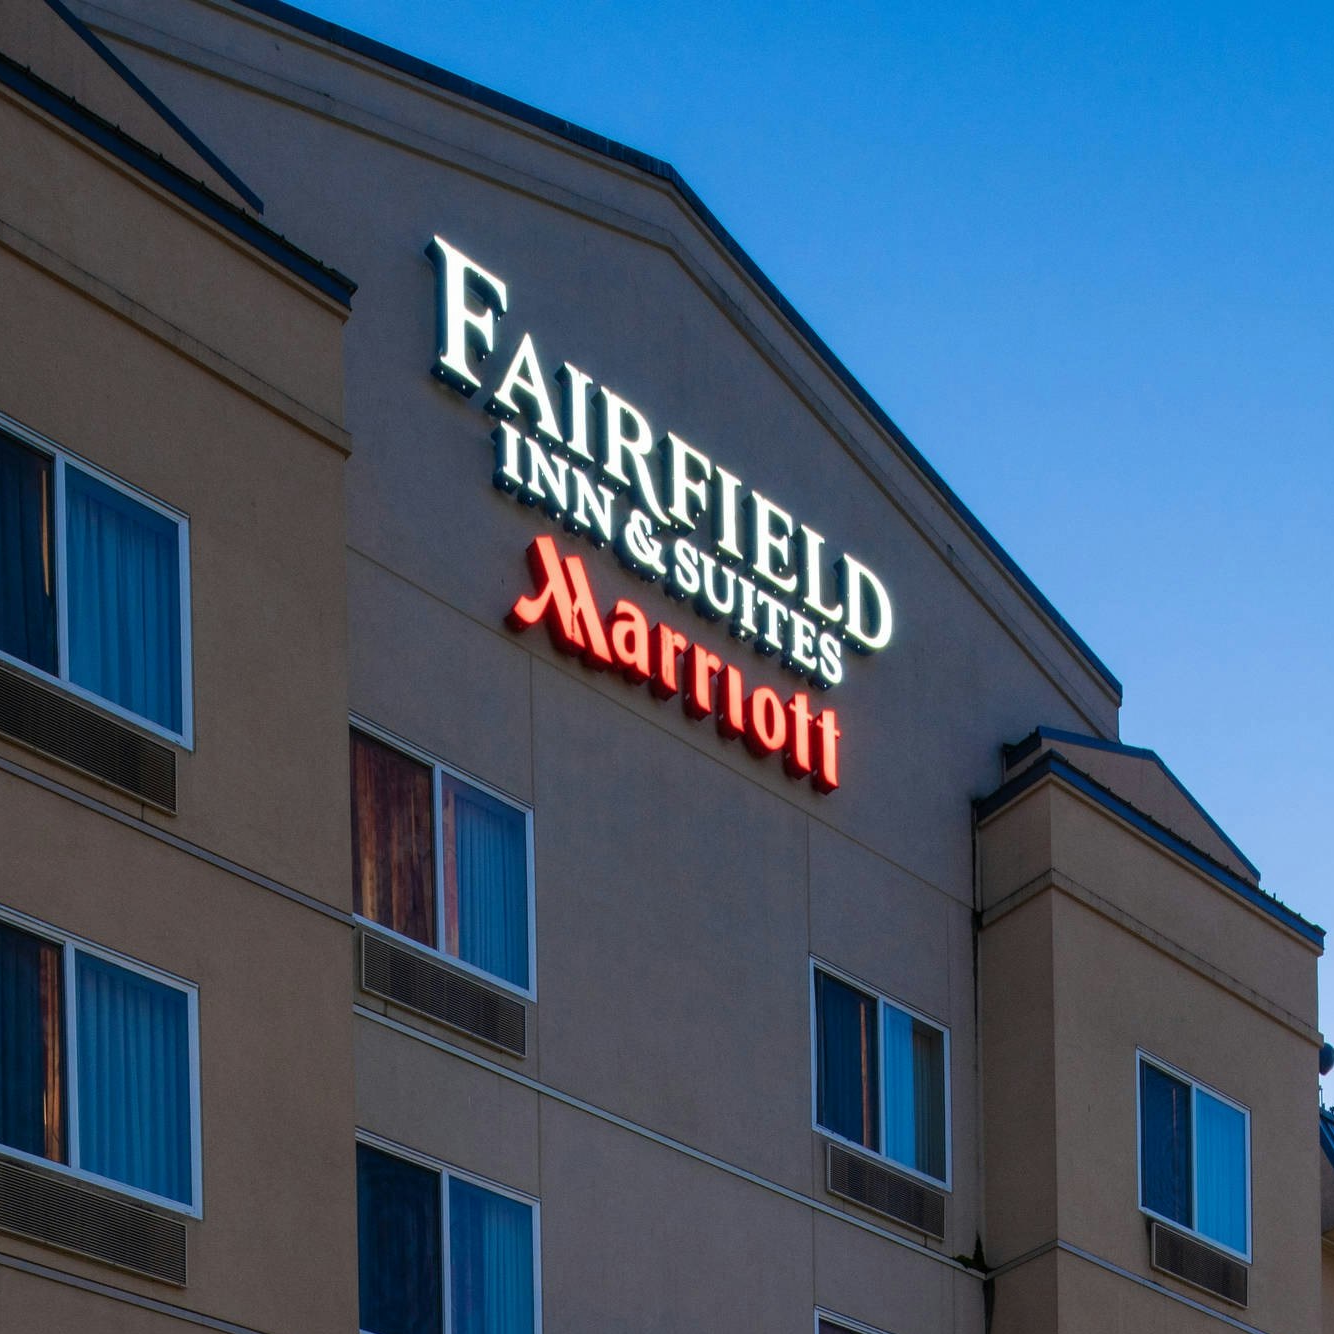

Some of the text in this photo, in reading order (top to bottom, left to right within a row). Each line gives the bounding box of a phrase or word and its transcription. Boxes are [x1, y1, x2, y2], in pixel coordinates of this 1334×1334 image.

[427, 234, 894, 652] FAIRFIELD
[496, 420, 843, 688] INN & SUITES
[507, 534, 840, 793] Marriott
